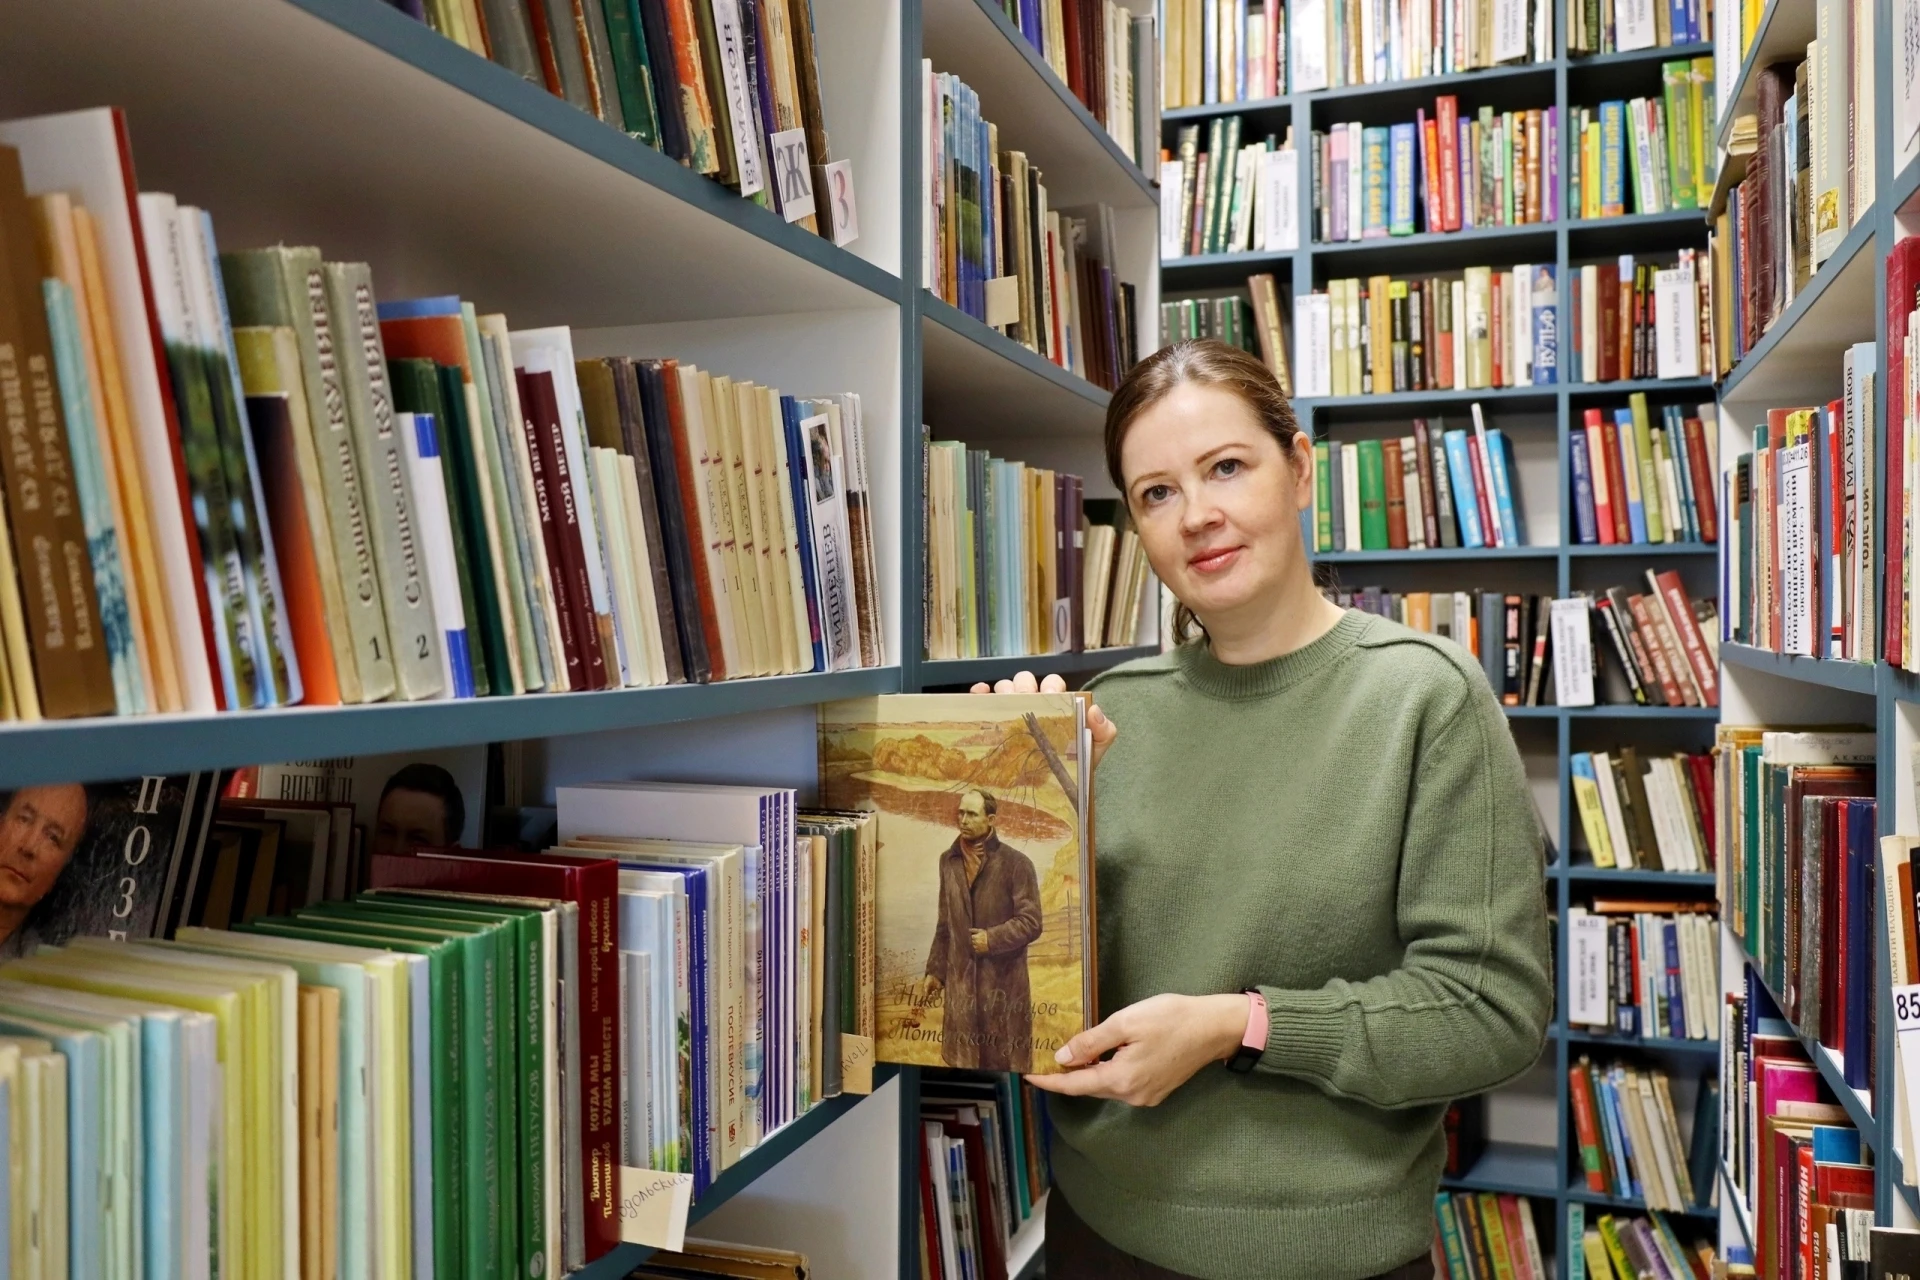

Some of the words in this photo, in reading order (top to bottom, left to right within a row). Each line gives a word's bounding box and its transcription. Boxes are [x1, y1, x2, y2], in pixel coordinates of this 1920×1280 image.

[724, 23, 754, 187] ЕРМАКОВ
[777, 140, 811, 204] Ж
[832, 169, 851, 230] З
[307, 268, 345, 431] КУНЯЕВ
[355, 282, 392, 440] КУНЯЕВ
[525, 418, 541, 476] ВЕТЕР
[550, 421, 567, 477] ВЕТЕР
[535, 480, 551, 524] МОЙ
[560, 481, 576, 525] МОЙ
[823, 523, 846, 658] МИШЕНЕВ
[368, 635, 383, 662] 1
[415, 634, 430, 661] 2
[1886, 874, 1895, 934] НАРОДНОЙ
[1891, 937, 1899, 984] ПАМЯТИ
[527, 939, 538, 1045] избранное
[590, 1054, 599, 1083] МЫ
[602, 1016, 612, 1073] ВМЕСТЕ
[590, 1086, 600, 1132] КОГДА
[602, 1075, 613, 1126] БУДЕМ
[1800, 1164, 1808, 1246] ЕСЕНИН
